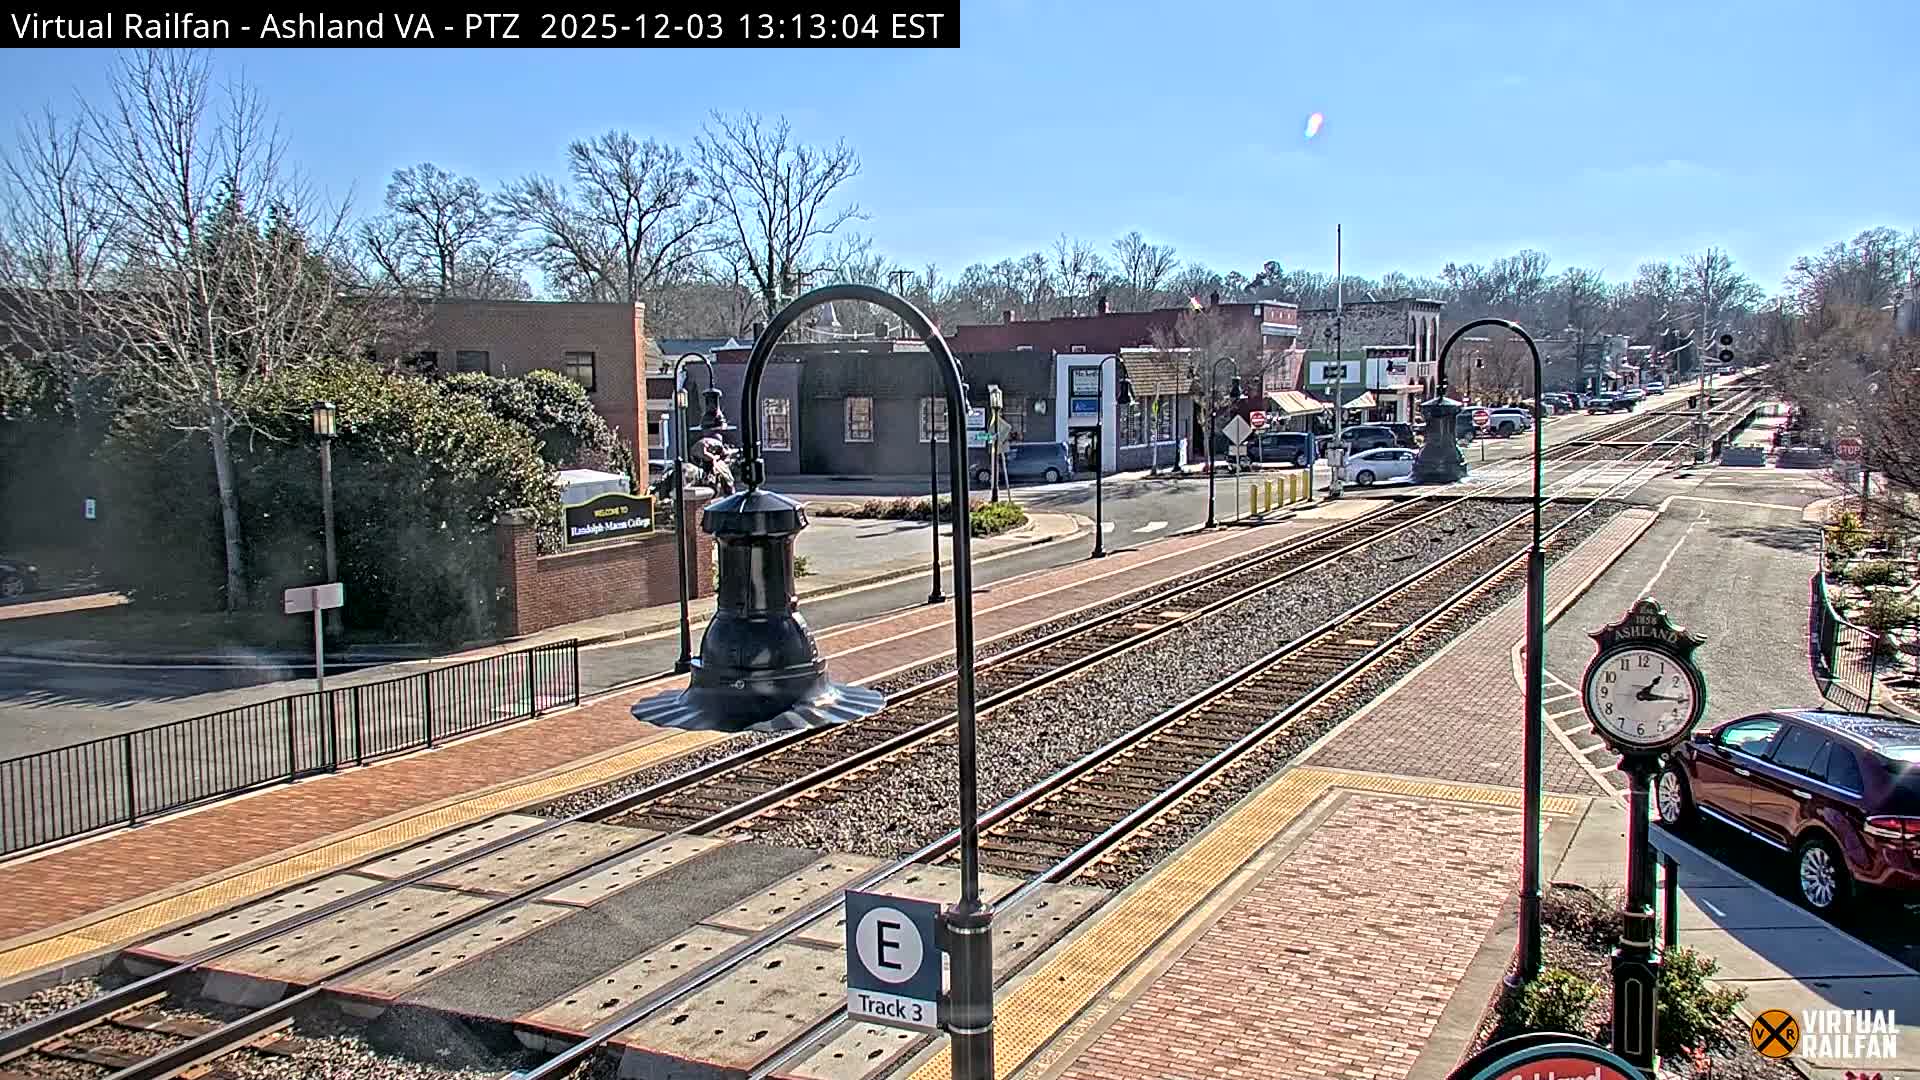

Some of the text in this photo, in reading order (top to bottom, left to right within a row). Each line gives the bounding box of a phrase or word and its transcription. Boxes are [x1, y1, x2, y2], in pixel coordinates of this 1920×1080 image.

[1837, 445, 1861, 456] STOP
[1615, 625, 1678, 643] ASHLAND
[1620, 659, 1629, 671] 11
[1637, 655, 1650, 667] 12
[1604, 671, 1616, 683] 10
[1672, 676, 1680, 688] 2
[1600, 686, 1609, 698] 9
[1605, 703, 1613, 715] 8
[1618, 718, 1625, 729] 7
[1636, 723, 1645, 735] 6
[1657, 721, 1665, 732] 5
[877, 920, 902, 970] E
[858, 994, 923, 1022] Track 3
